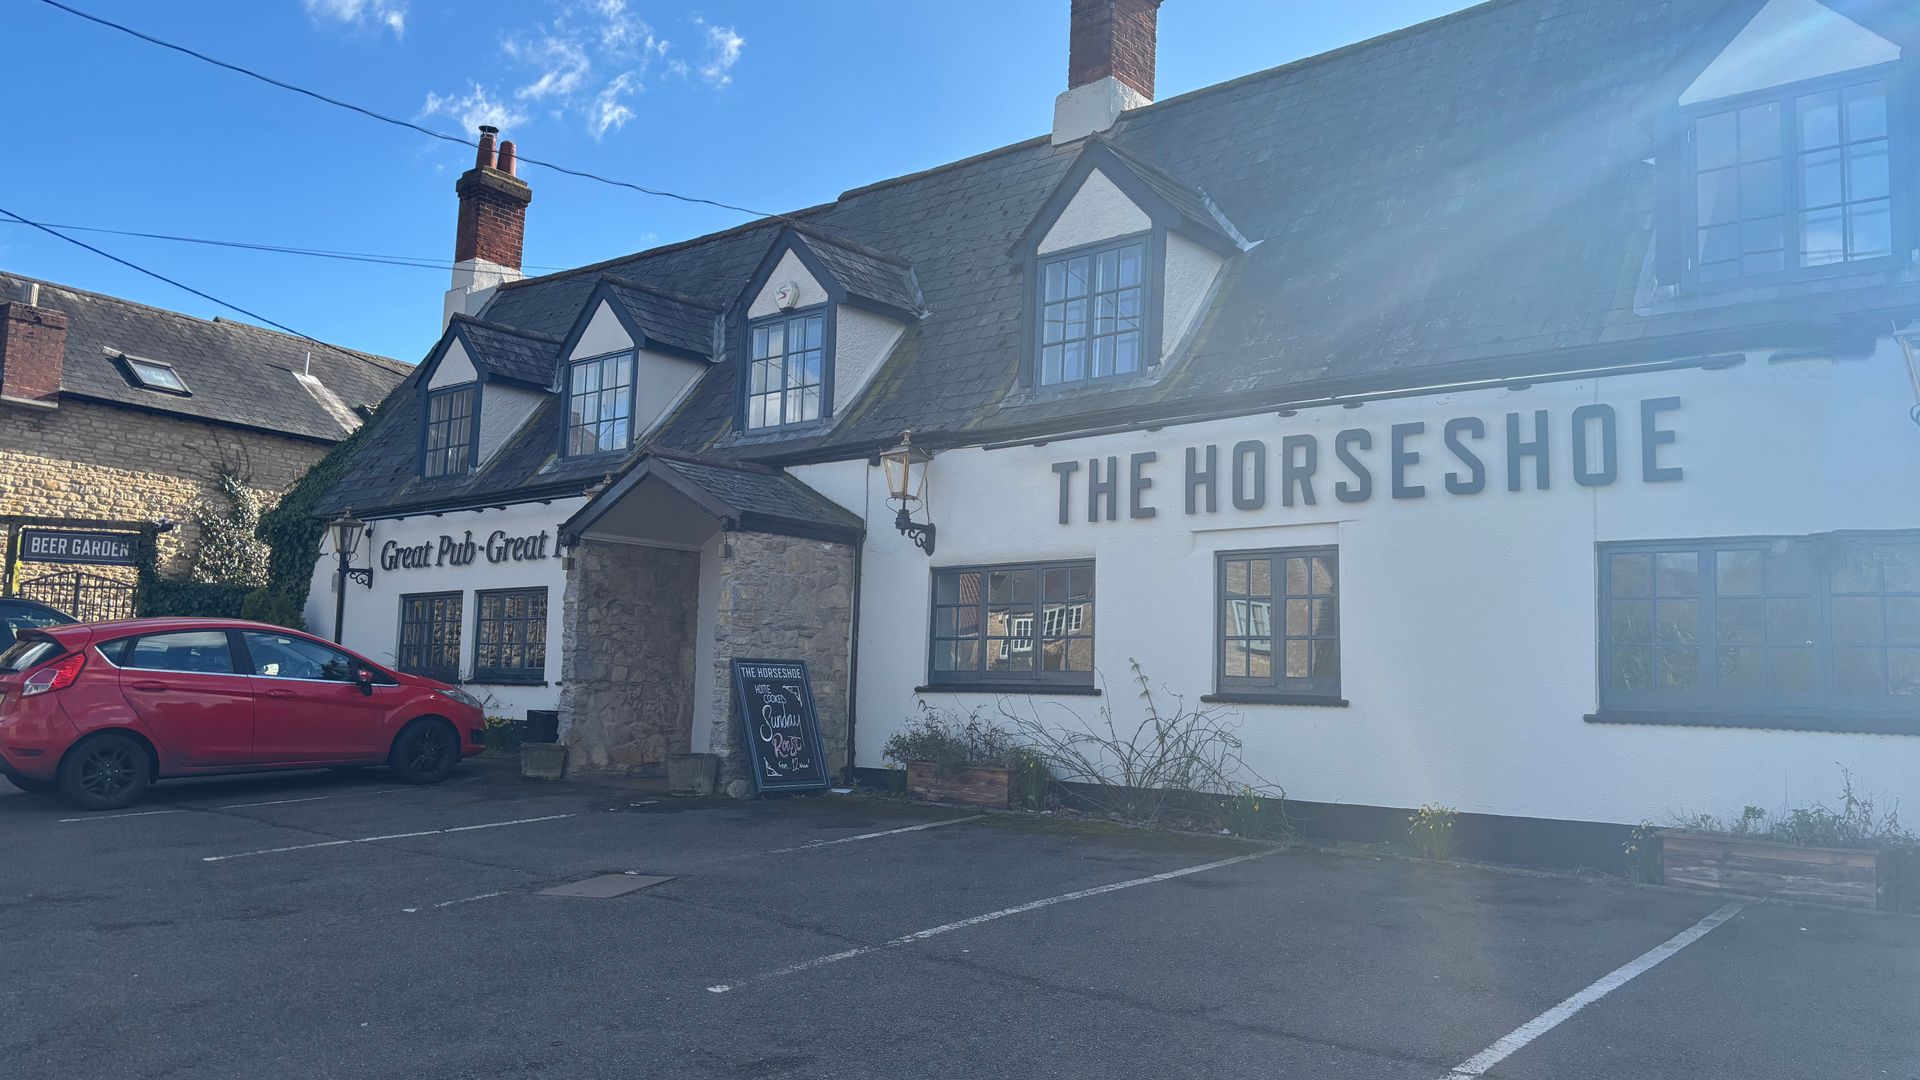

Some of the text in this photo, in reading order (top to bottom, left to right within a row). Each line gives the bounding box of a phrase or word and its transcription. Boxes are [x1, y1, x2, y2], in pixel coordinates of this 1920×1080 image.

[1051, 396, 1684, 525] THE HORSESHOE
[31, 537, 130, 557] BEER GARDEN
[380, 539, 434, 571] Great
[741, 667, 802, 679] THE HORSESHOE
[760, 703, 805, 748] Sunday
[772, 733, 802, 758] Roast
